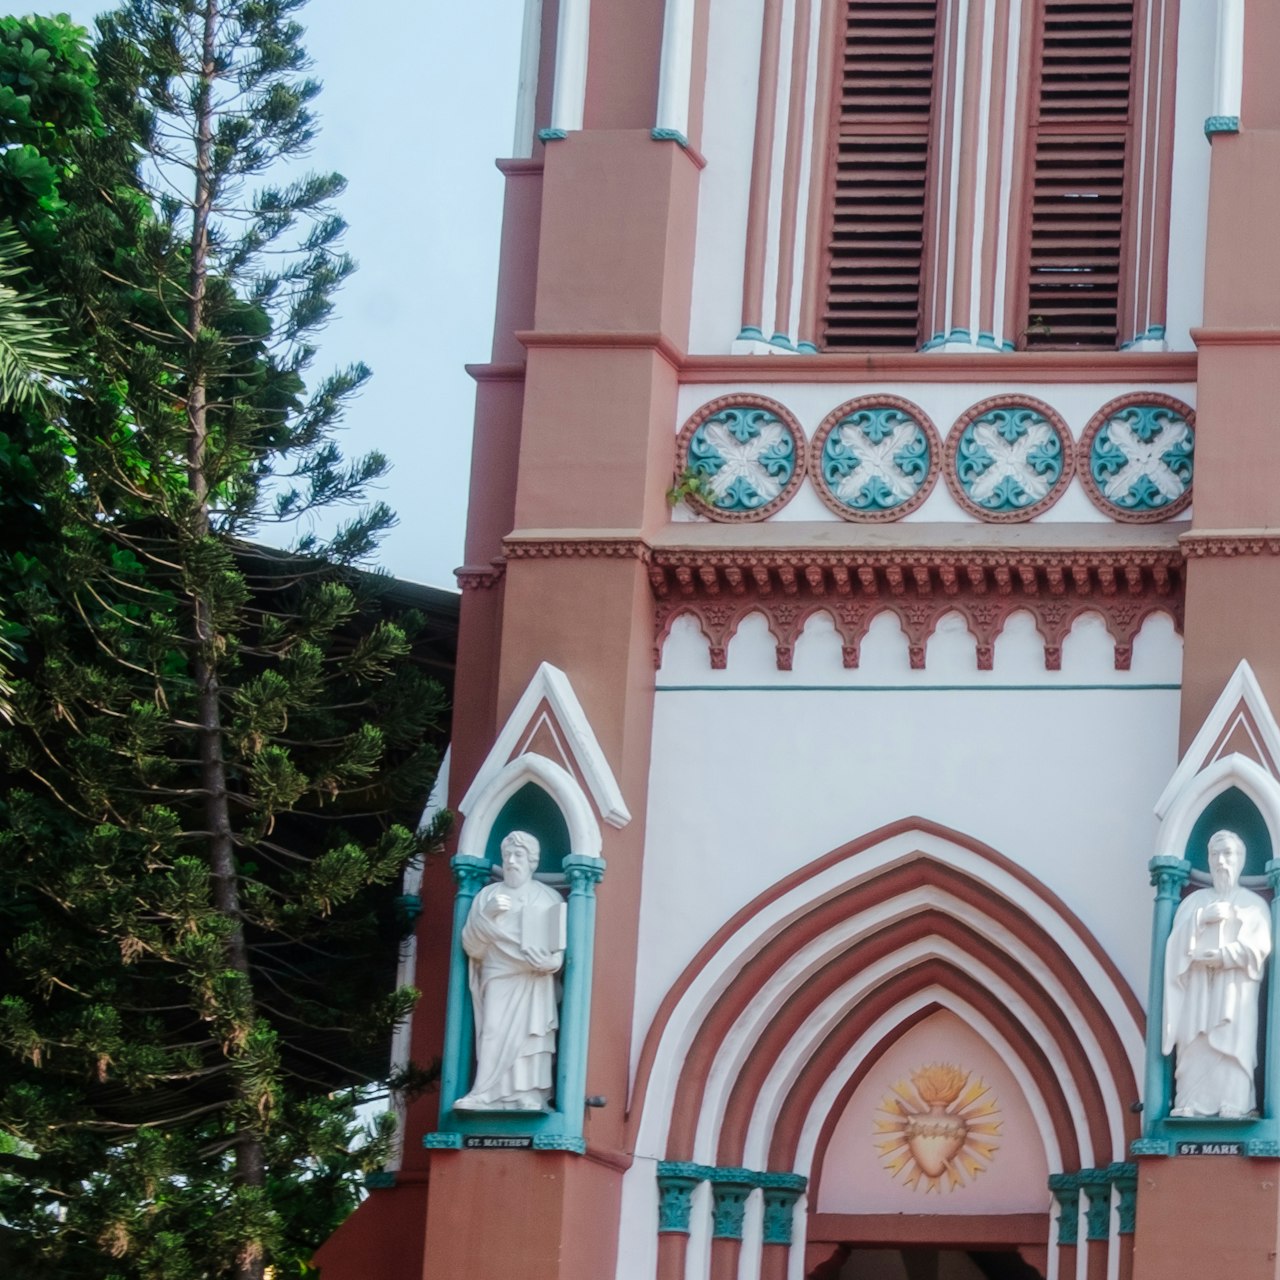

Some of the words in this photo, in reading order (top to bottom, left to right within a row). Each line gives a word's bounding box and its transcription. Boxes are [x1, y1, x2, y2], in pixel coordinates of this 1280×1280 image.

[467, 1138, 481, 1147] ST.
[483, 1138, 531, 1147] MATTHEW
[1180, 1144, 1198, 1154] ST.
[1201, 1144, 1239, 1154] MARK
